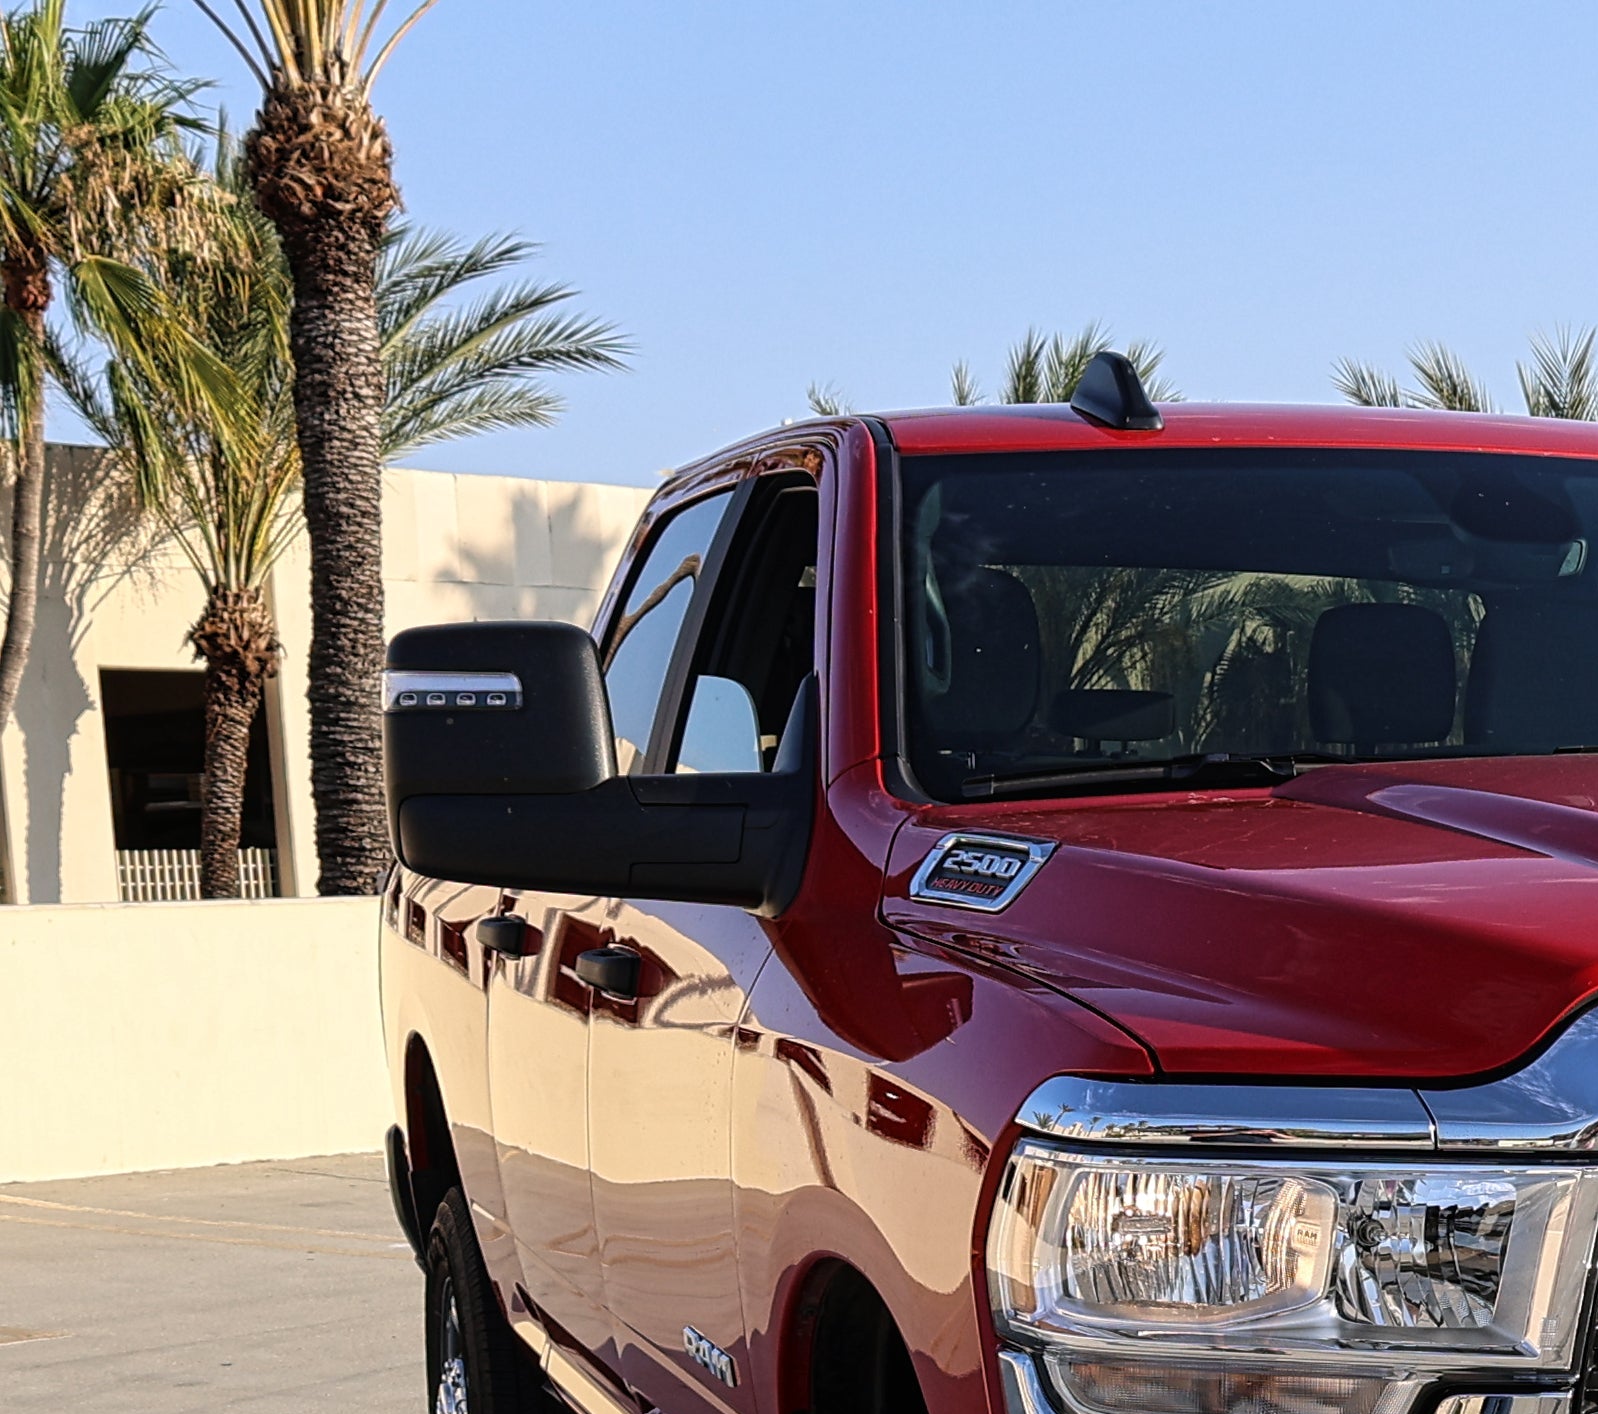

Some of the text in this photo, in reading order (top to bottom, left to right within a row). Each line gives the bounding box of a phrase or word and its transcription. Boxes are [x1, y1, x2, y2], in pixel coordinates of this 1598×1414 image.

[943, 850, 1021, 879] 2500
[930, 877, 1004, 896] HEAVY DUTY
[1297, 1229, 1318, 1240] RAM
[683, 1325, 736, 1388] RAM
